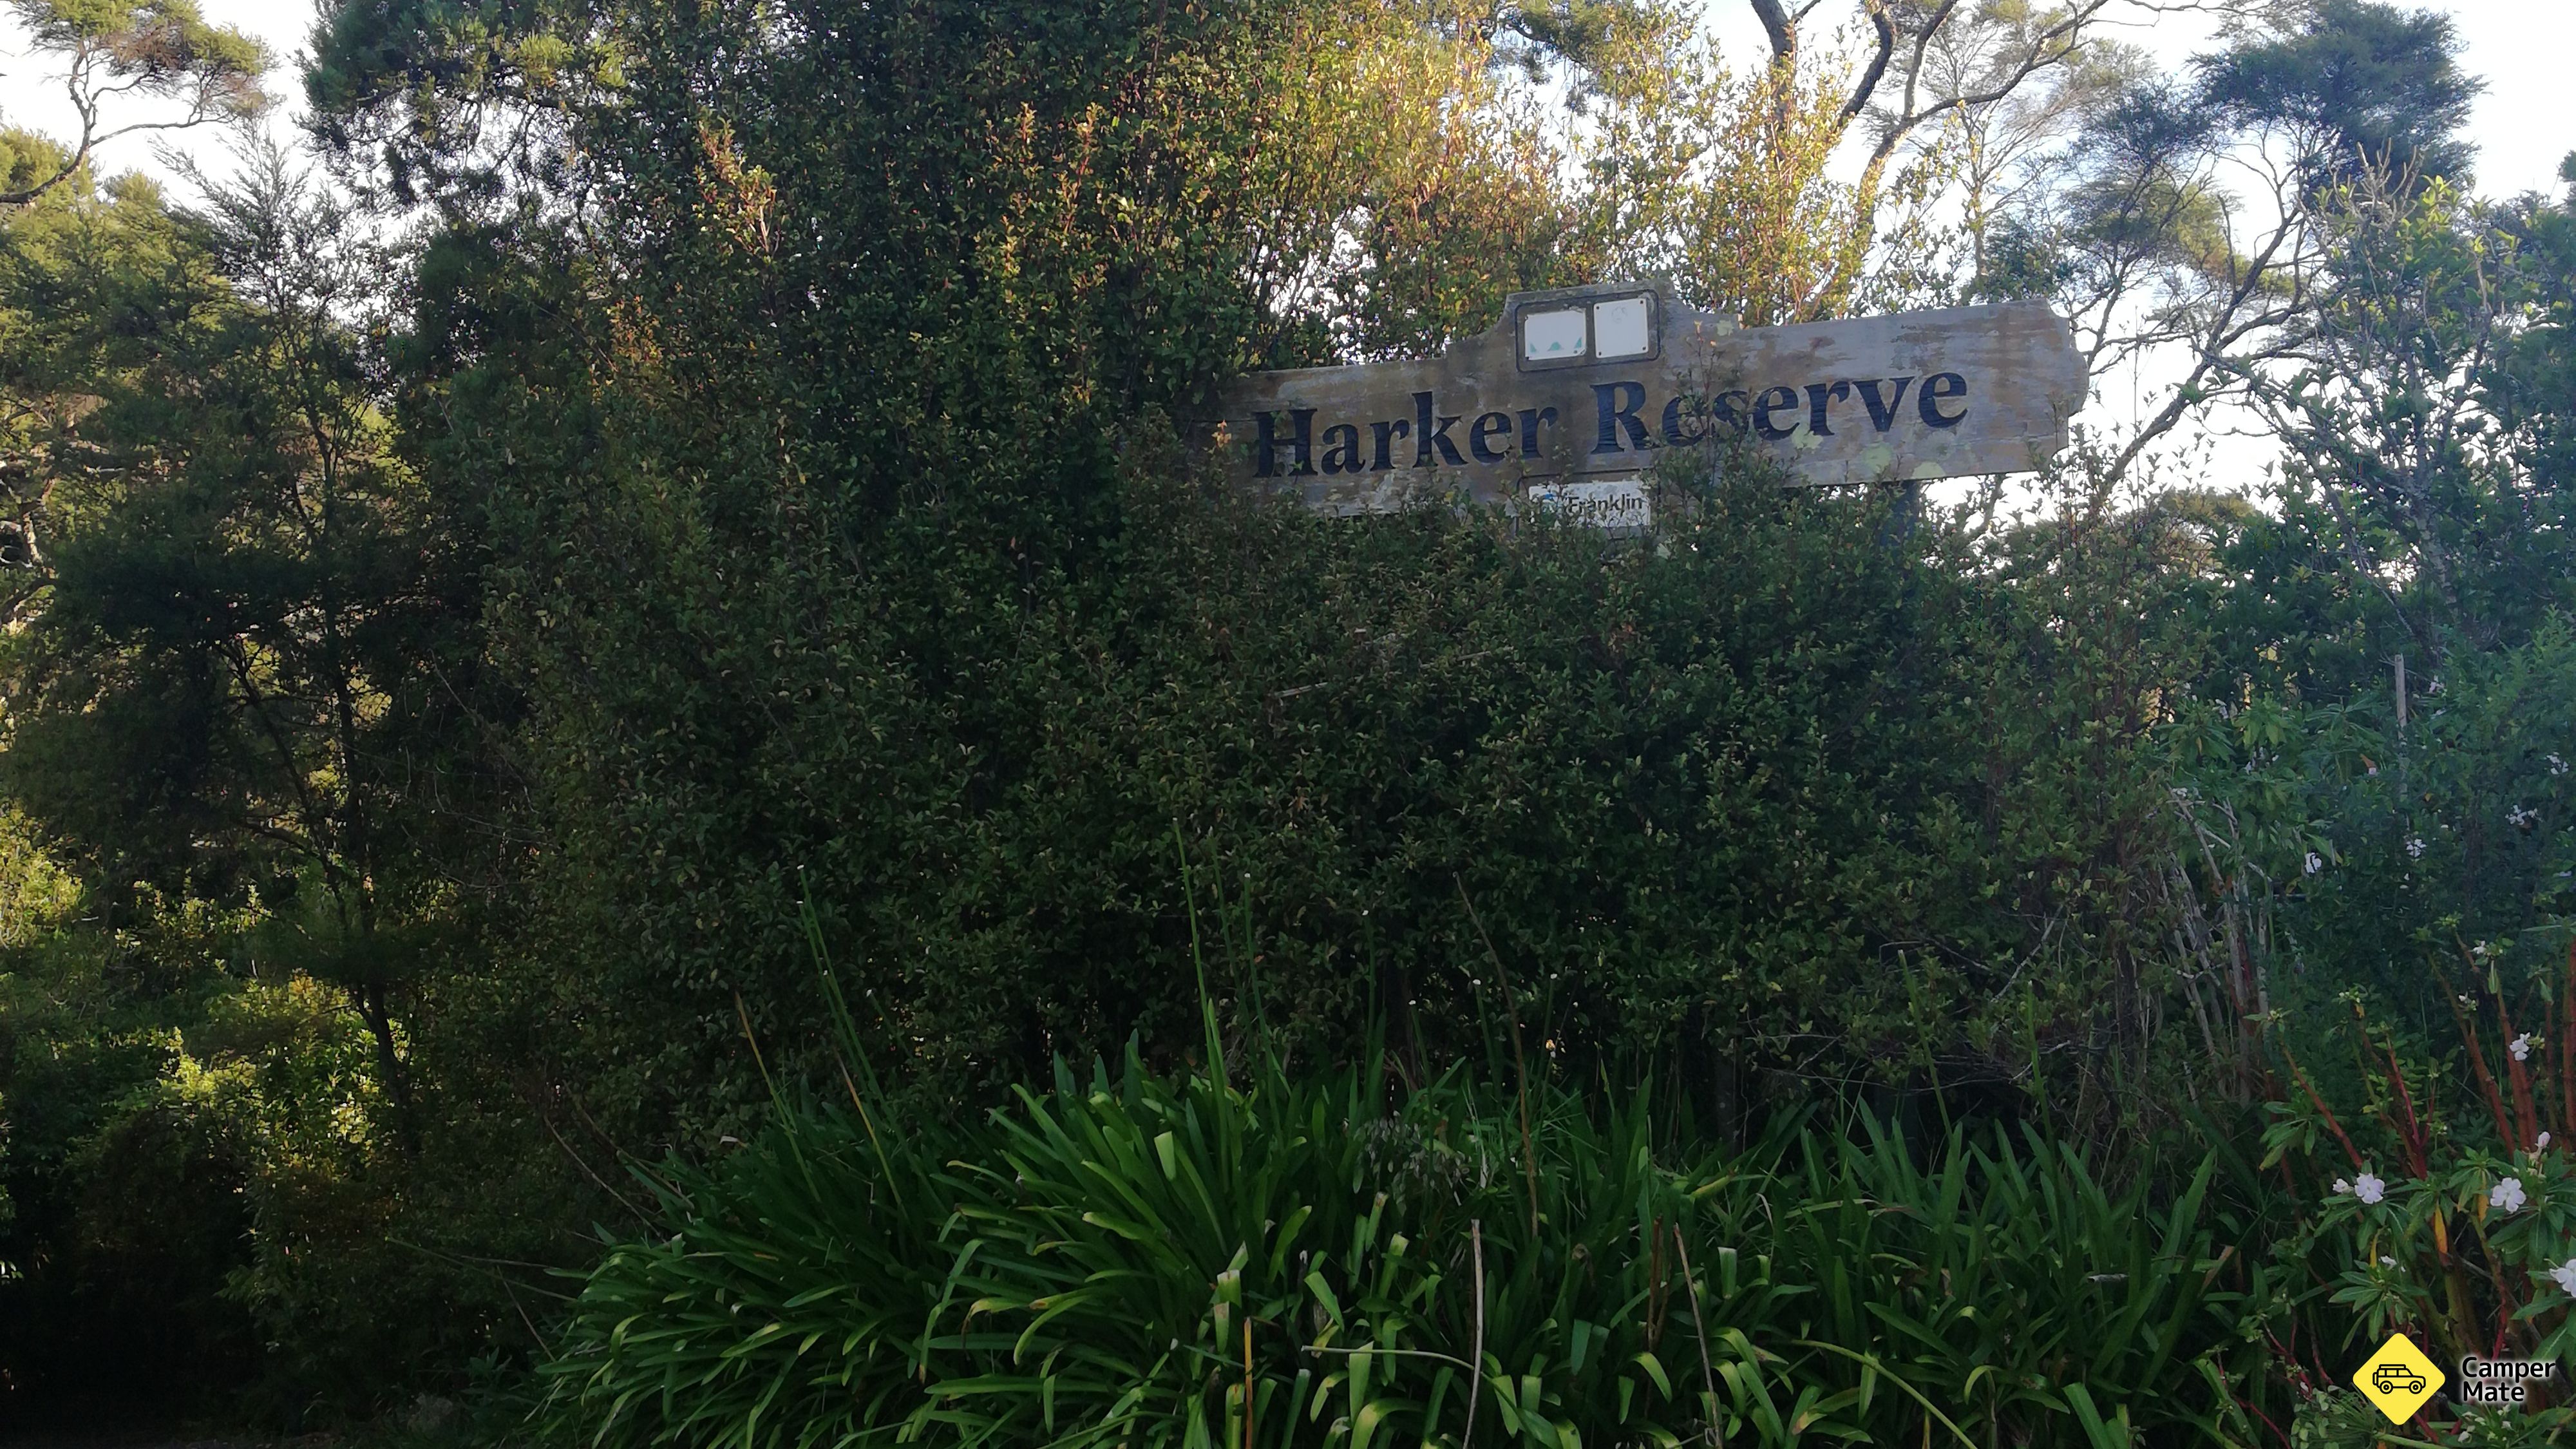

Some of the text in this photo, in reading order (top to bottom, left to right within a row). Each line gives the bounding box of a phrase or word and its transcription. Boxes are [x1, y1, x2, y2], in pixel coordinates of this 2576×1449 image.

[1252, 372, 1968, 478] Harker Reserve
[1569, 493, 1642, 514] Franklin
